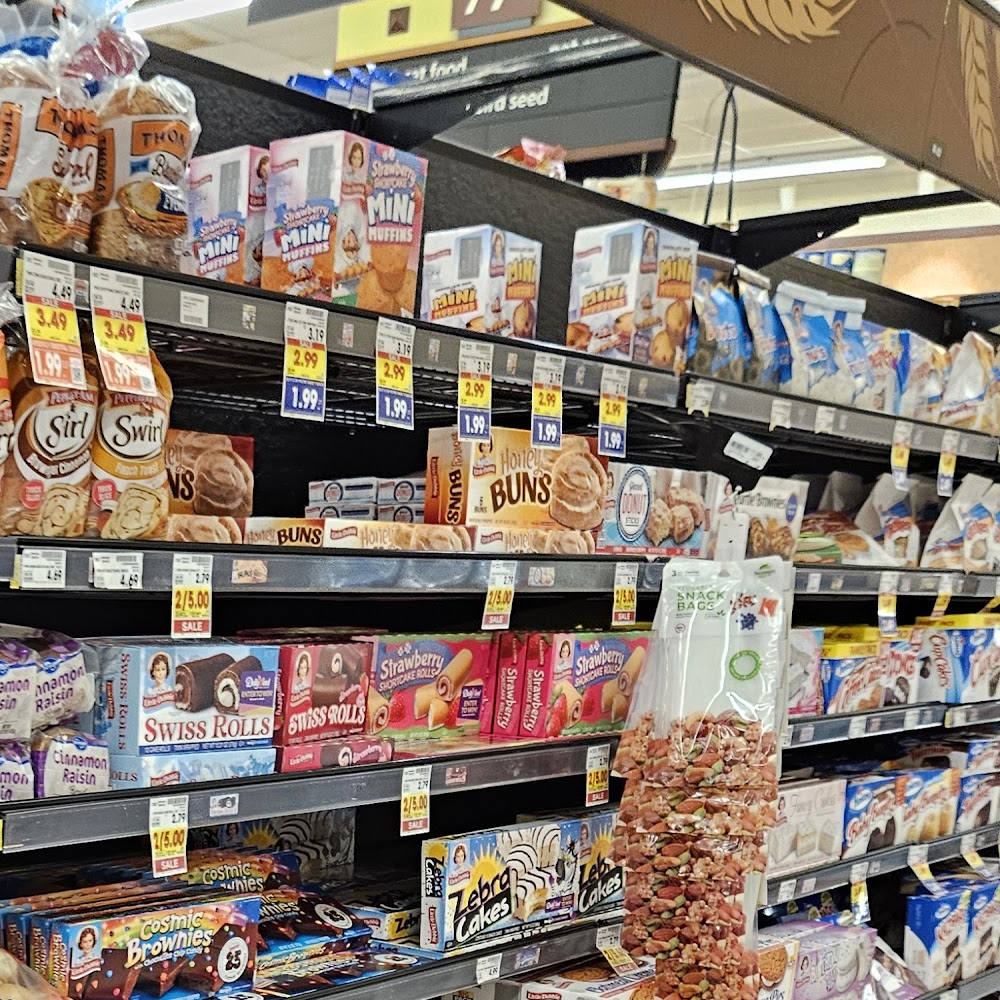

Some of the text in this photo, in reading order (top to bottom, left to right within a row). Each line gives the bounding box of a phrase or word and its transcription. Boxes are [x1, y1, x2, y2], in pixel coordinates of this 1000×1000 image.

[429, 56, 468, 75] food
[508, 85, 550, 110] seed
[367, 188, 415, 225] MINI
[282, 219, 330, 251] MINI
[369, 226, 413, 242] MUFFINS
[199, 234, 239, 262] MINI
[283, 243, 329, 262] MUFFINS
[51, 284, 72, 300] 4.49
[120, 297, 141, 312] 4.49
[36, 309, 68, 331] 3.49
[103, 323, 136, 342] 3.49
[309, 327, 325, 343] 3.19
[292, 350, 318, 371] 2.99
[383, 363, 406, 381] 2.99
[291, 385, 318, 411] 1.99
[465, 380, 485, 398] 2.99
[538, 389, 557, 408] 2.99
[383, 396, 408, 420] 1.99
[114, 415, 164, 447] Swirl
[537, 421, 557, 442] 1.99
[604, 431, 621, 450] 1.99
[490, 472, 551, 513] BUNS
[622, 494, 647, 515] DONUT
[626, 517, 639, 525] STICKS
[277, 521, 323, 546] BUNS
[175, 589, 210, 610] 2/5.00
[677, 591, 724, 600] SNACK
[677, 602, 714, 611] BAGS
[181, 621, 203, 632] SALE
[380, 654, 444, 680] Strawberry
[576, 651, 624, 676] Strawberry
[378, 668, 436, 692] SHORTCAKE ROLLS
[497, 668, 518, 730] Strawberry
[144, 715, 270, 742] SWISS ROLLS
[288, 704, 366, 734] SWISS ROLLS
[53, 750, 107, 770] Cinnamon
[64, 769, 96, 785] Raisin
[588, 771, 608, 785] 2/5.00
[403, 794, 428, 811] 2/5.00
[152, 829, 185, 849] 2/5.00
[425, 859, 433, 896] Cakes
[450, 866, 511, 923] Zebra
[579, 872, 621, 913] Cakes
[140, 911, 204, 940] Cosmic
[456, 897, 508, 943] Cakes
[125, 928, 214, 969] Brownies
[226, 950, 242, 972] 25
[527, 991, 543, 1000] Little
